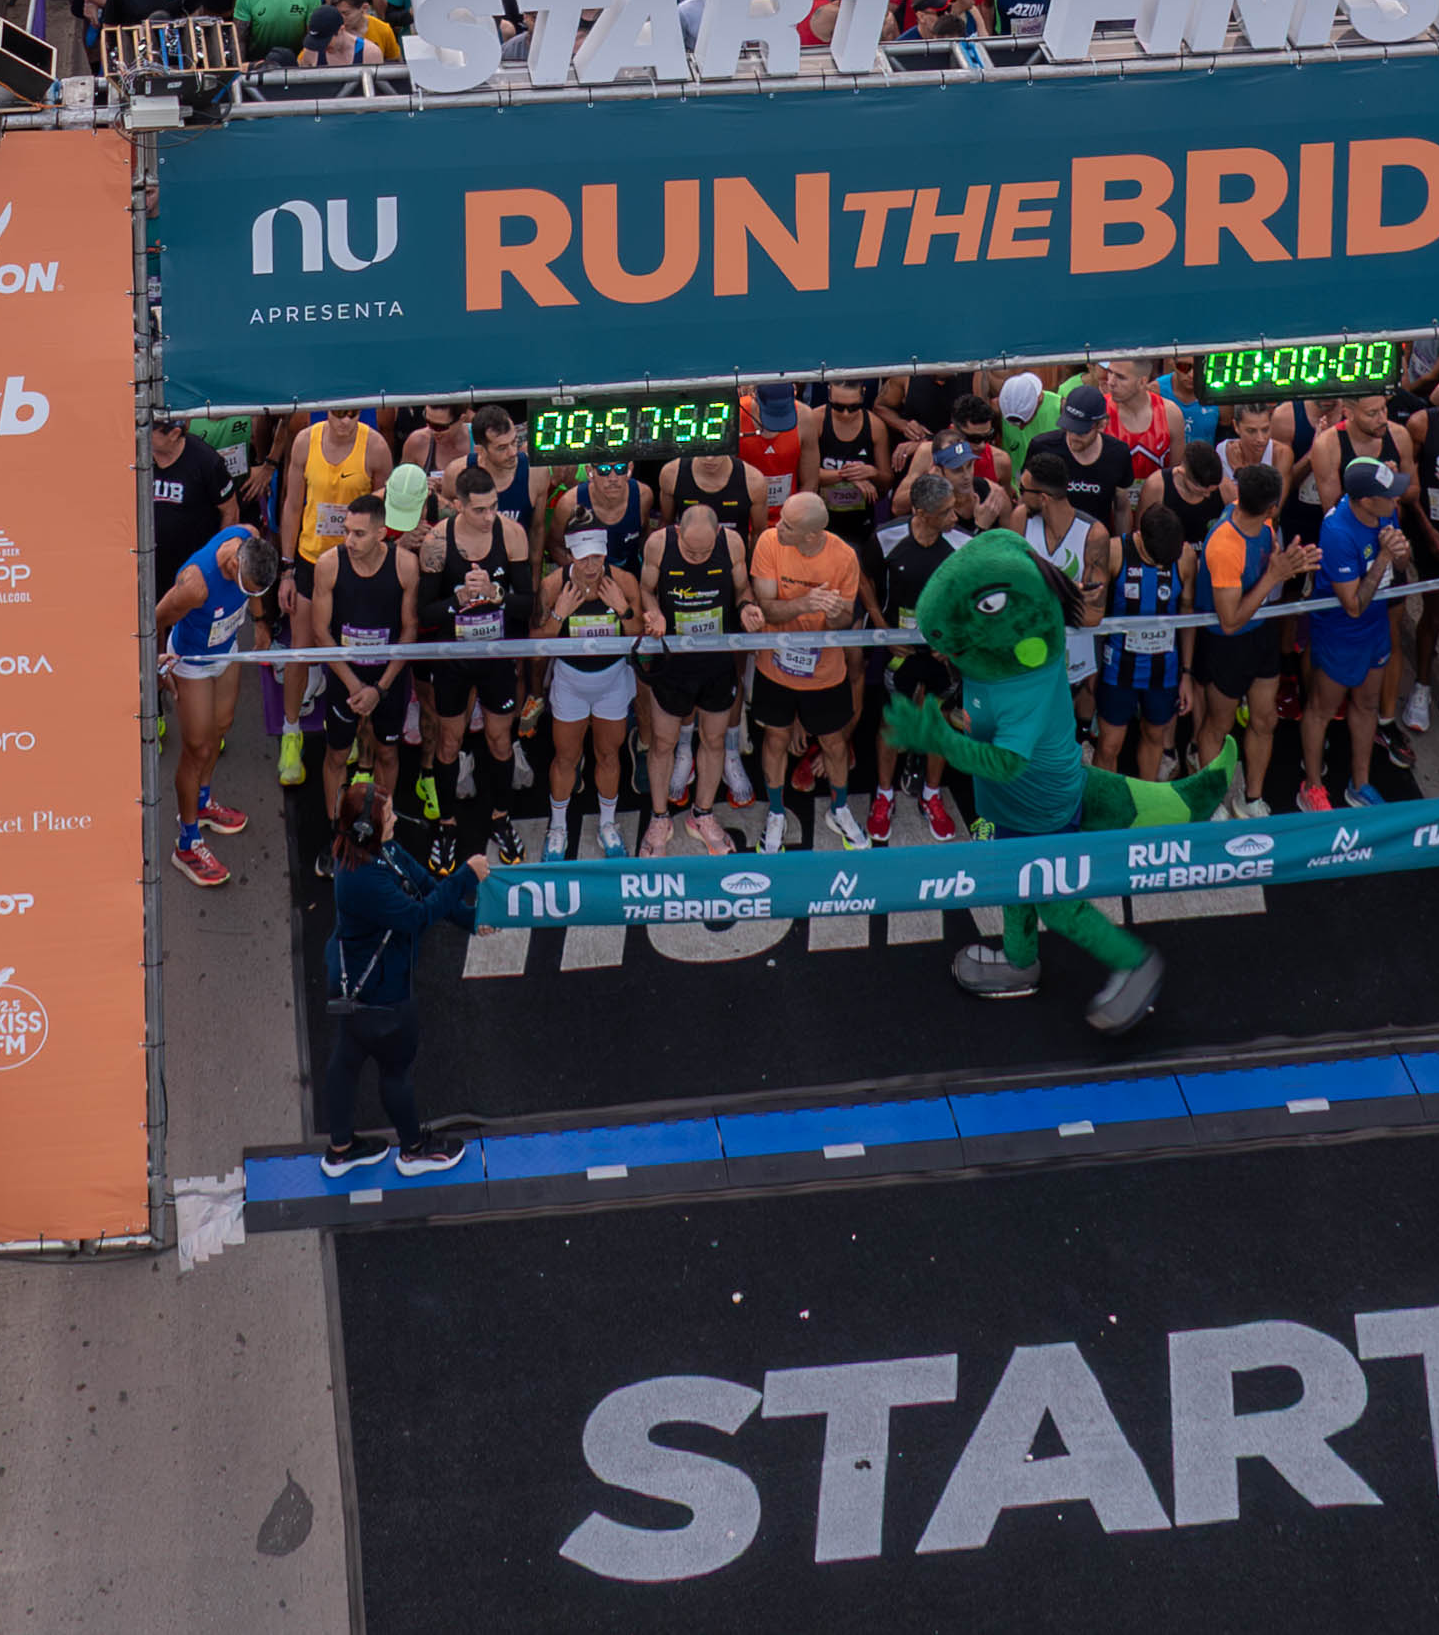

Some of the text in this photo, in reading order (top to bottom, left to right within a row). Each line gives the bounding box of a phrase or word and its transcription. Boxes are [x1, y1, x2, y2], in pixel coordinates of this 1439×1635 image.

[465, 172, 830, 311] RUN
[843, 180, 1060, 269] THE
[249, 299, 405, 326] APRESENTA
[1204, 341, 1394, 389] 00:00:00
[535, 402, 730, 452] 00:57:52
[33, 810, 92, 833] Place
[621, 873, 685, 898] RUN
[808, 898, 875, 915] NEWON
[919, 870, 977, 902] rvb
[1128, 840, 1191, 867] RUN
[1307, 845, 1373, 869] NEWON
[1129, 859, 1274, 890] THE BRIDGE
[623, 898, 772, 921] THE BRIDGE
